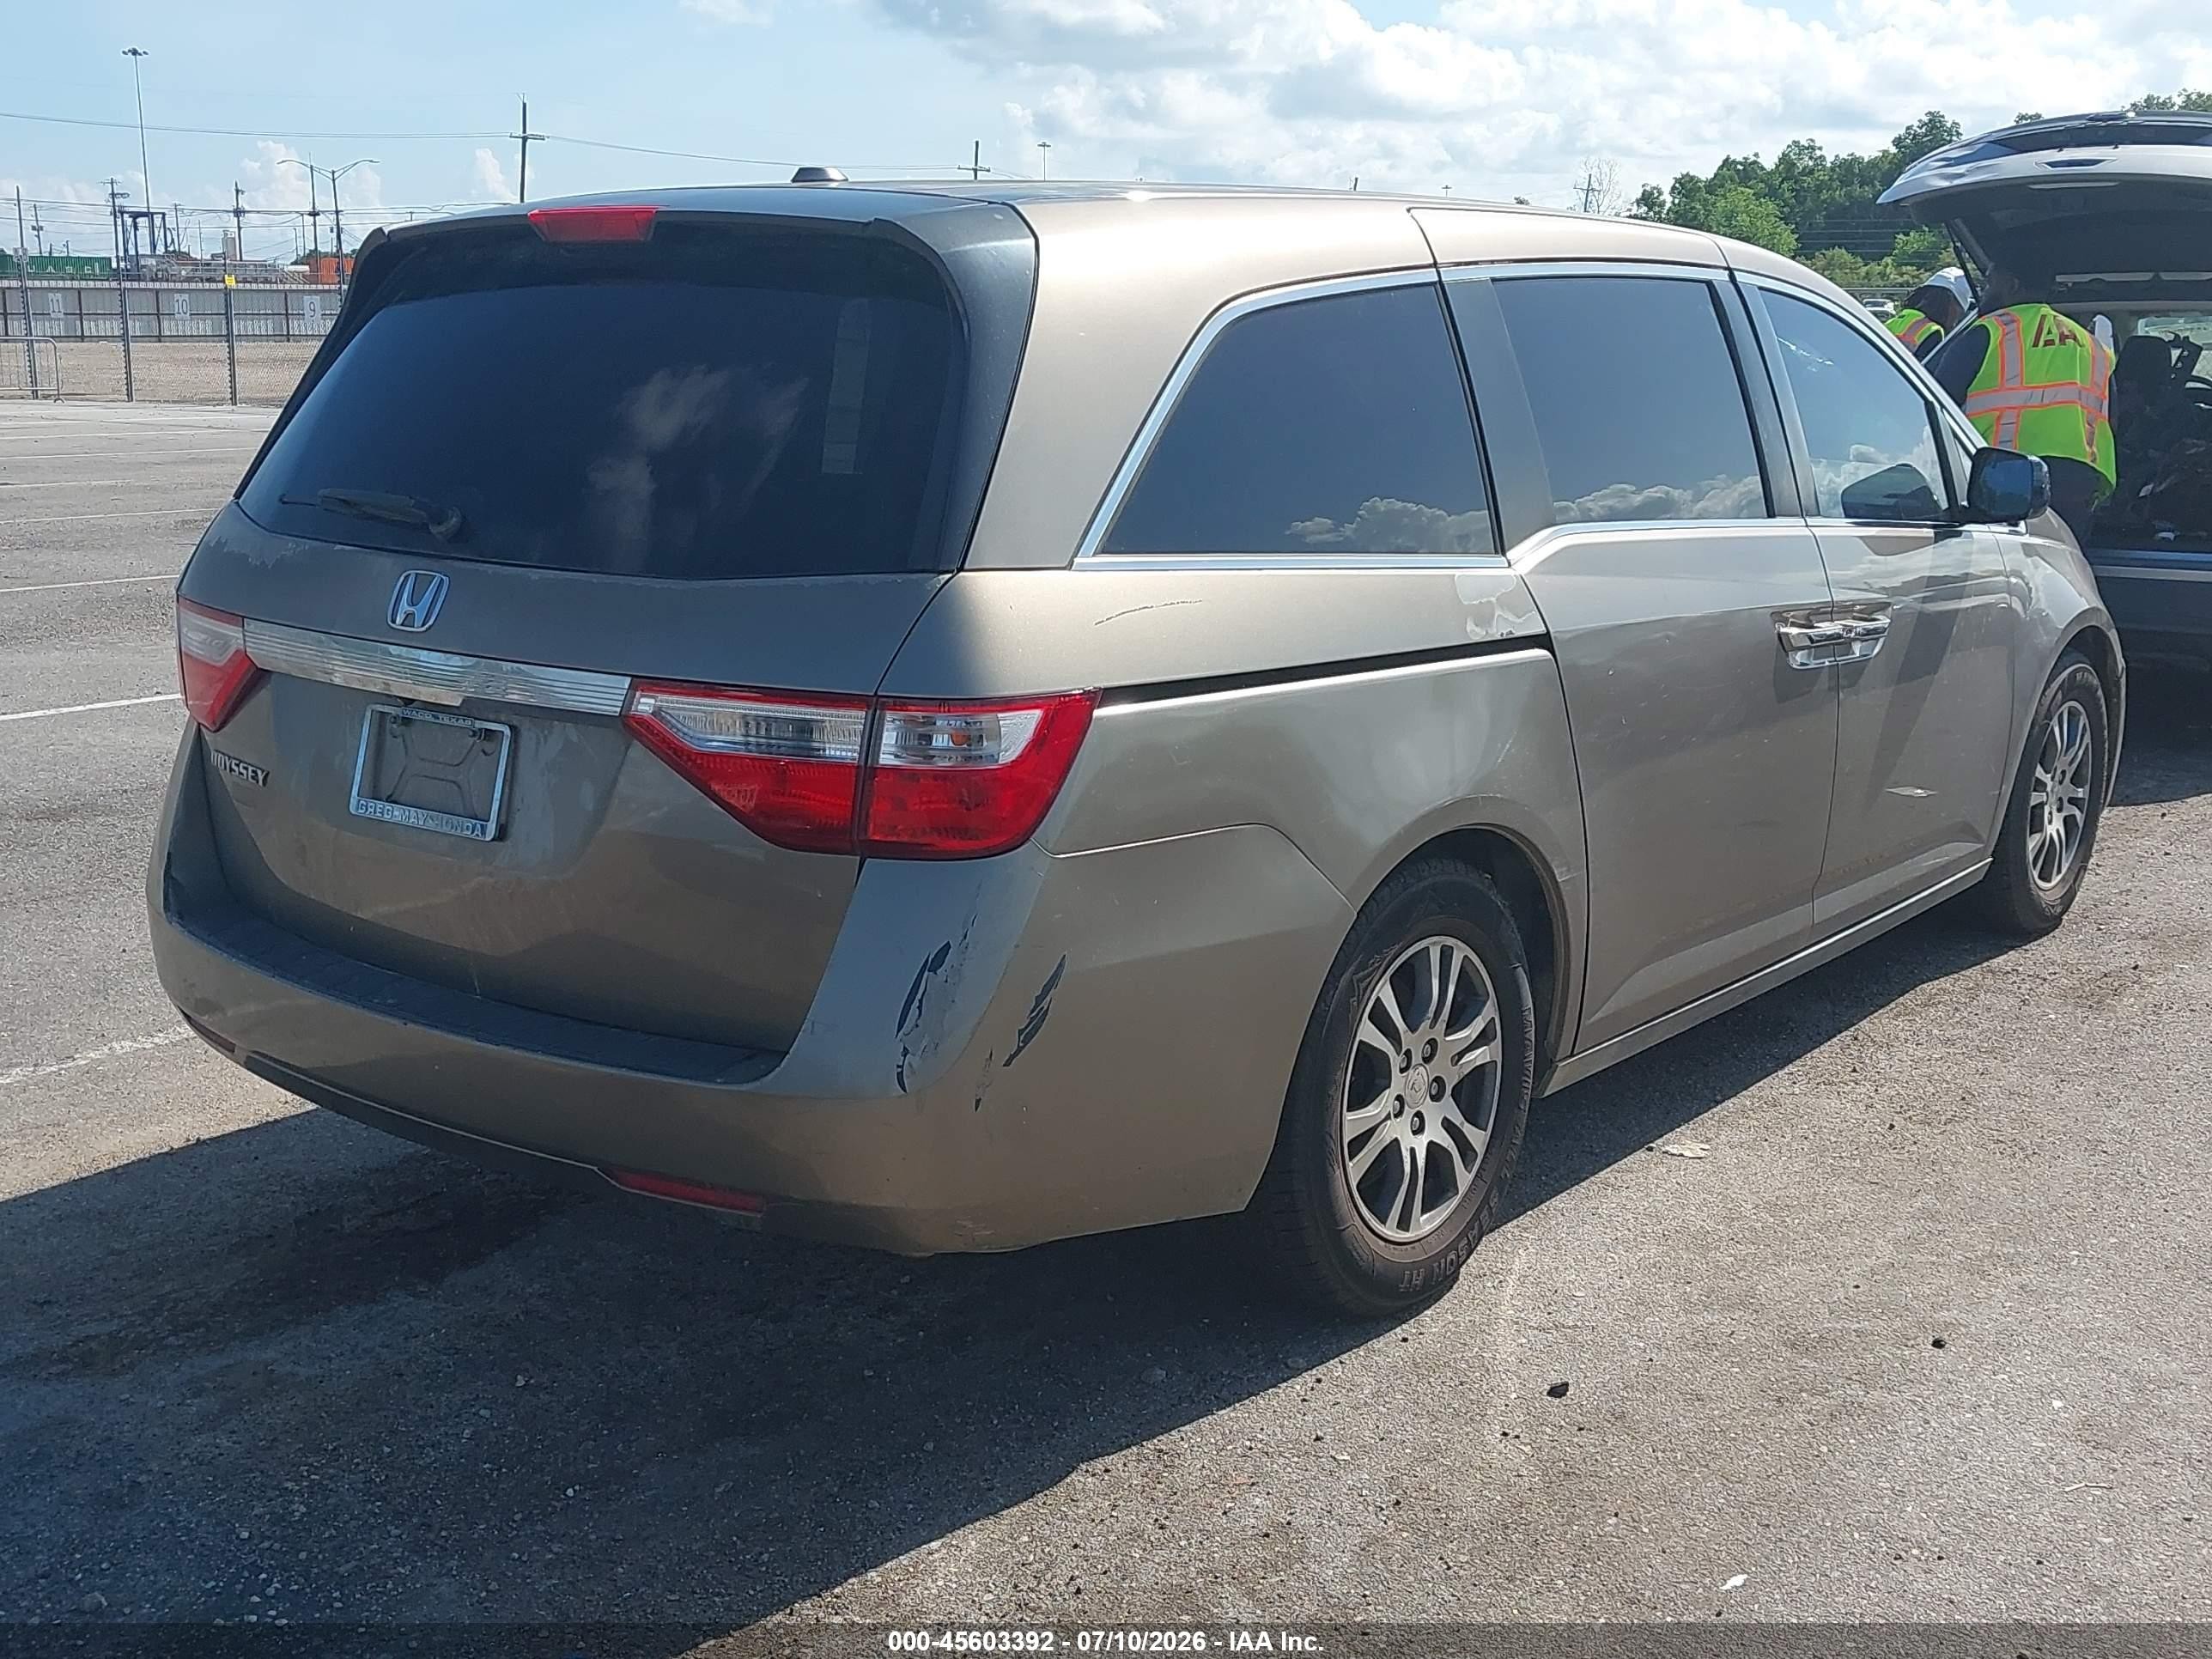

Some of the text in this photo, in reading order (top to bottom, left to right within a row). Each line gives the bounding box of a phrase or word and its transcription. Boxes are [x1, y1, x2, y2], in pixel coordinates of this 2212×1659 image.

[50, 298, 63, 313] 11
[175, 299, 188, 315] 10
[308, 301, 317, 318] 9
